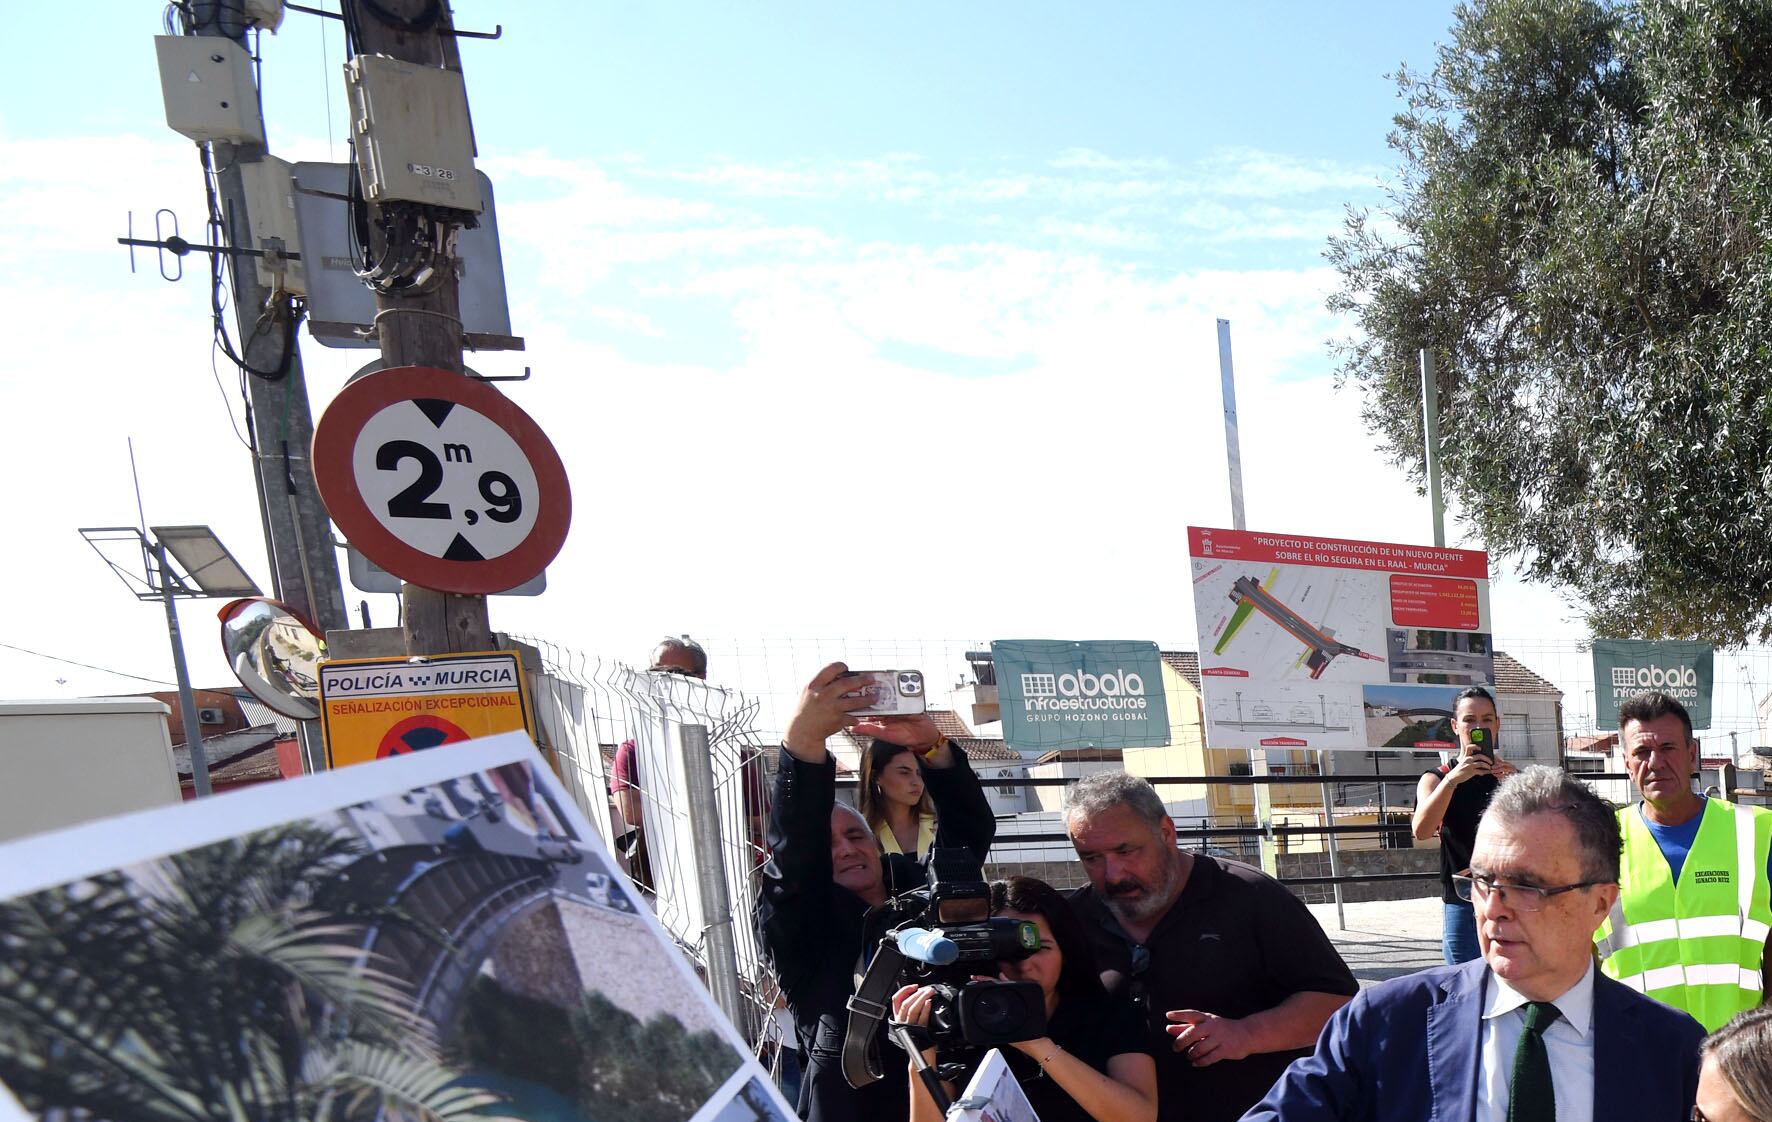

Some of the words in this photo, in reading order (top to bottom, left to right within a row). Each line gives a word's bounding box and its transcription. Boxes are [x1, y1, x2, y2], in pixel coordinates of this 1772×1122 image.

[1275, 551, 1302, 561] SOBRE
[1304, 553, 1313, 562] EL
[1314, 553, 1329, 563] RÍO
[1330, 555, 1364, 566] SEGURA
[1365, 558, 1376, 567] EN
[1377, 559, 1386, 568] EL
[1387, 560, 1408, 569] RAAL
[1303, 541, 1314, 550] DE
[1315, 542, 1378, 554] CONSTRUCCIÓN
[1380, 547, 1391, 556] DE
[1392, 548, 1404, 557] UN
[1405, 550, 1433, 559] NUEVO
[1434, 552, 1464, 562] PUENTE
[327, 672, 403, 692] POLICÍA
[435, 668, 512, 685] MURCIA
[1058, 669, 1145, 697] abala
[1638, 664, 1697, 688] abala
[333, 698, 422, 715] SEÑALIZACIÓN
[426, 695, 516, 710] EXCEPCIONAL
[1025, 695, 1147, 711] infraestructuras
[1026, 713, 1061, 722] GRUPO
[1065, 713, 1109, 721] HOZONO
[1112, 712, 1148, 721] GLOBAL
